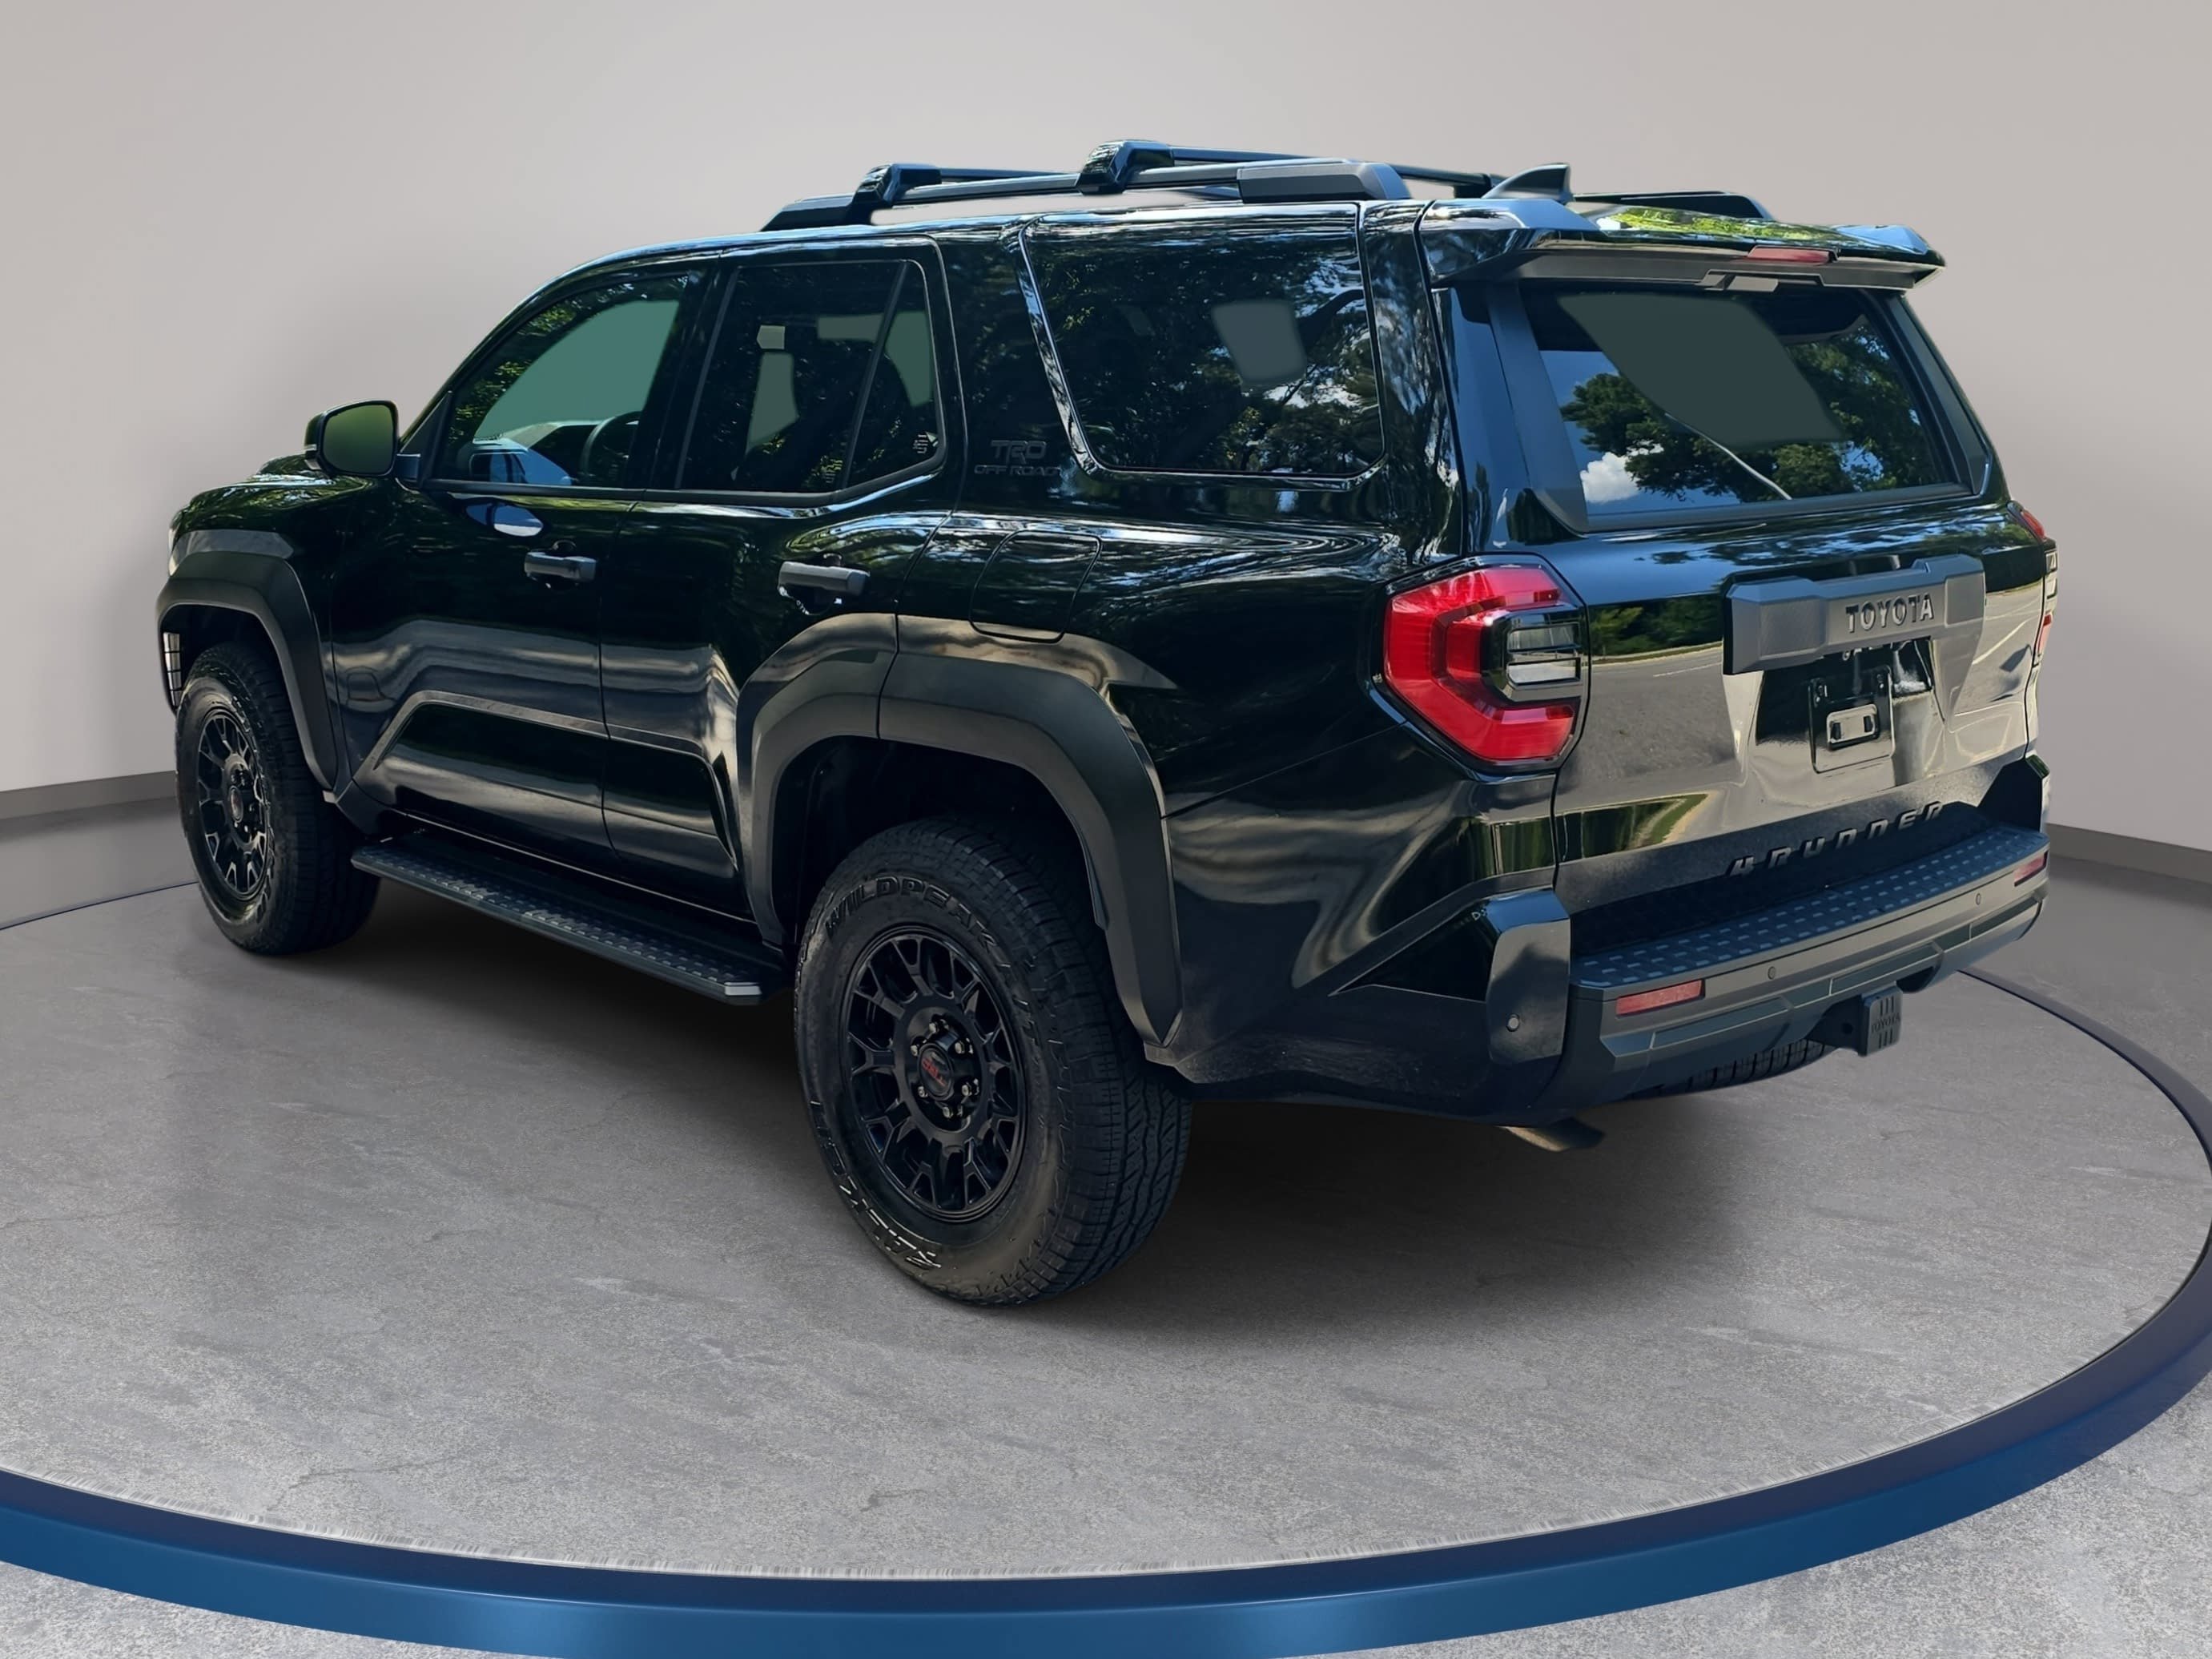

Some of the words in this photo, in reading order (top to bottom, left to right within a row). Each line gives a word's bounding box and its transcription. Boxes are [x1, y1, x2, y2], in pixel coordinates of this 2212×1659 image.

[989, 438, 1047, 464] TRD
[973, 464, 1007, 475] OFF
[1009, 465, 1061, 477] ROAD
[1845, 593, 1934, 634] TOYOTA
[1724, 801, 1944, 877] 4RUNNER
